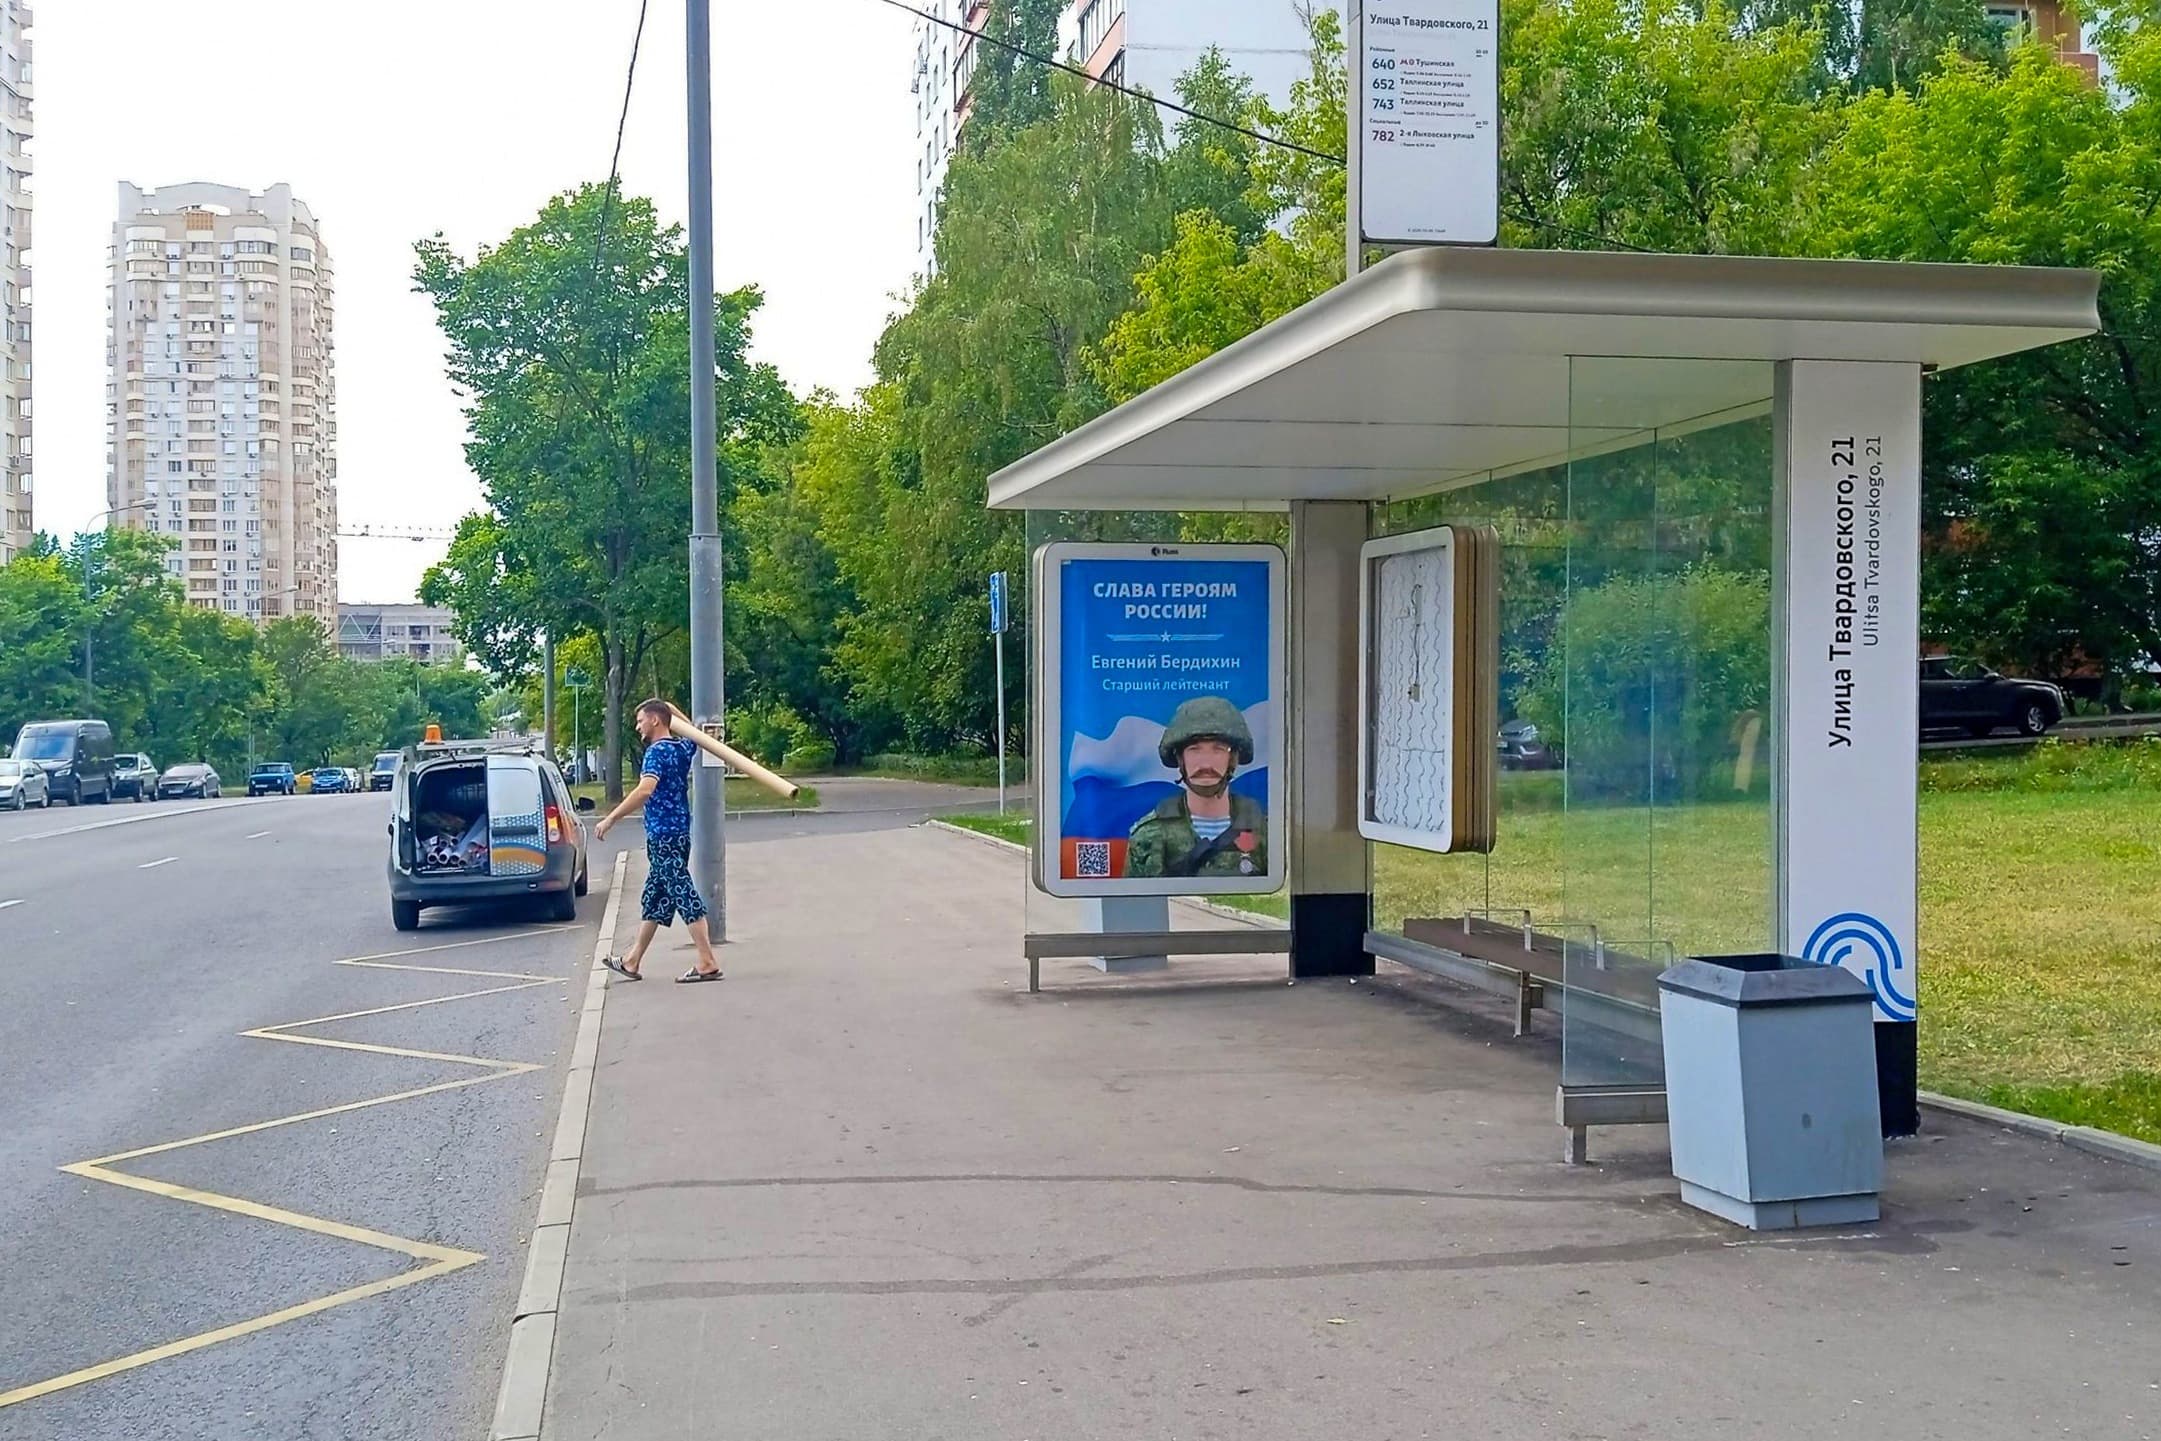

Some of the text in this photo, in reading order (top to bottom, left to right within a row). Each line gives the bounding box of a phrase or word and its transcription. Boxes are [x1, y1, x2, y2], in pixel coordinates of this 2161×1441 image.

[1370, 13, 1488, 31] Улица Твардовского, 21
[1372, 58, 1395, 70] 640
[1416, 59, 1455, 67] Тушинская
[1372, 79, 1395, 90] 652
[1400, 78, 1442, 88] Таллинская
[1372, 98, 1394, 110] 743
[1400, 98, 1442, 107] Таллинская
[1372, 130, 1395, 142] 782
[1863, 435, 1884, 646] Ulitsa Tvardovskogo, 21
[1093, 582, 1237, 599] СЛАВА ГЕРОЯМ
[1829, 436, 1859, 748] Улица Твардовского, 21
[1124, 603, 1208, 620] РОССИИ!
[1092, 653, 1240, 672] Евгений Бердихин
[1102, 678, 1230, 693] Старший лейтенант
